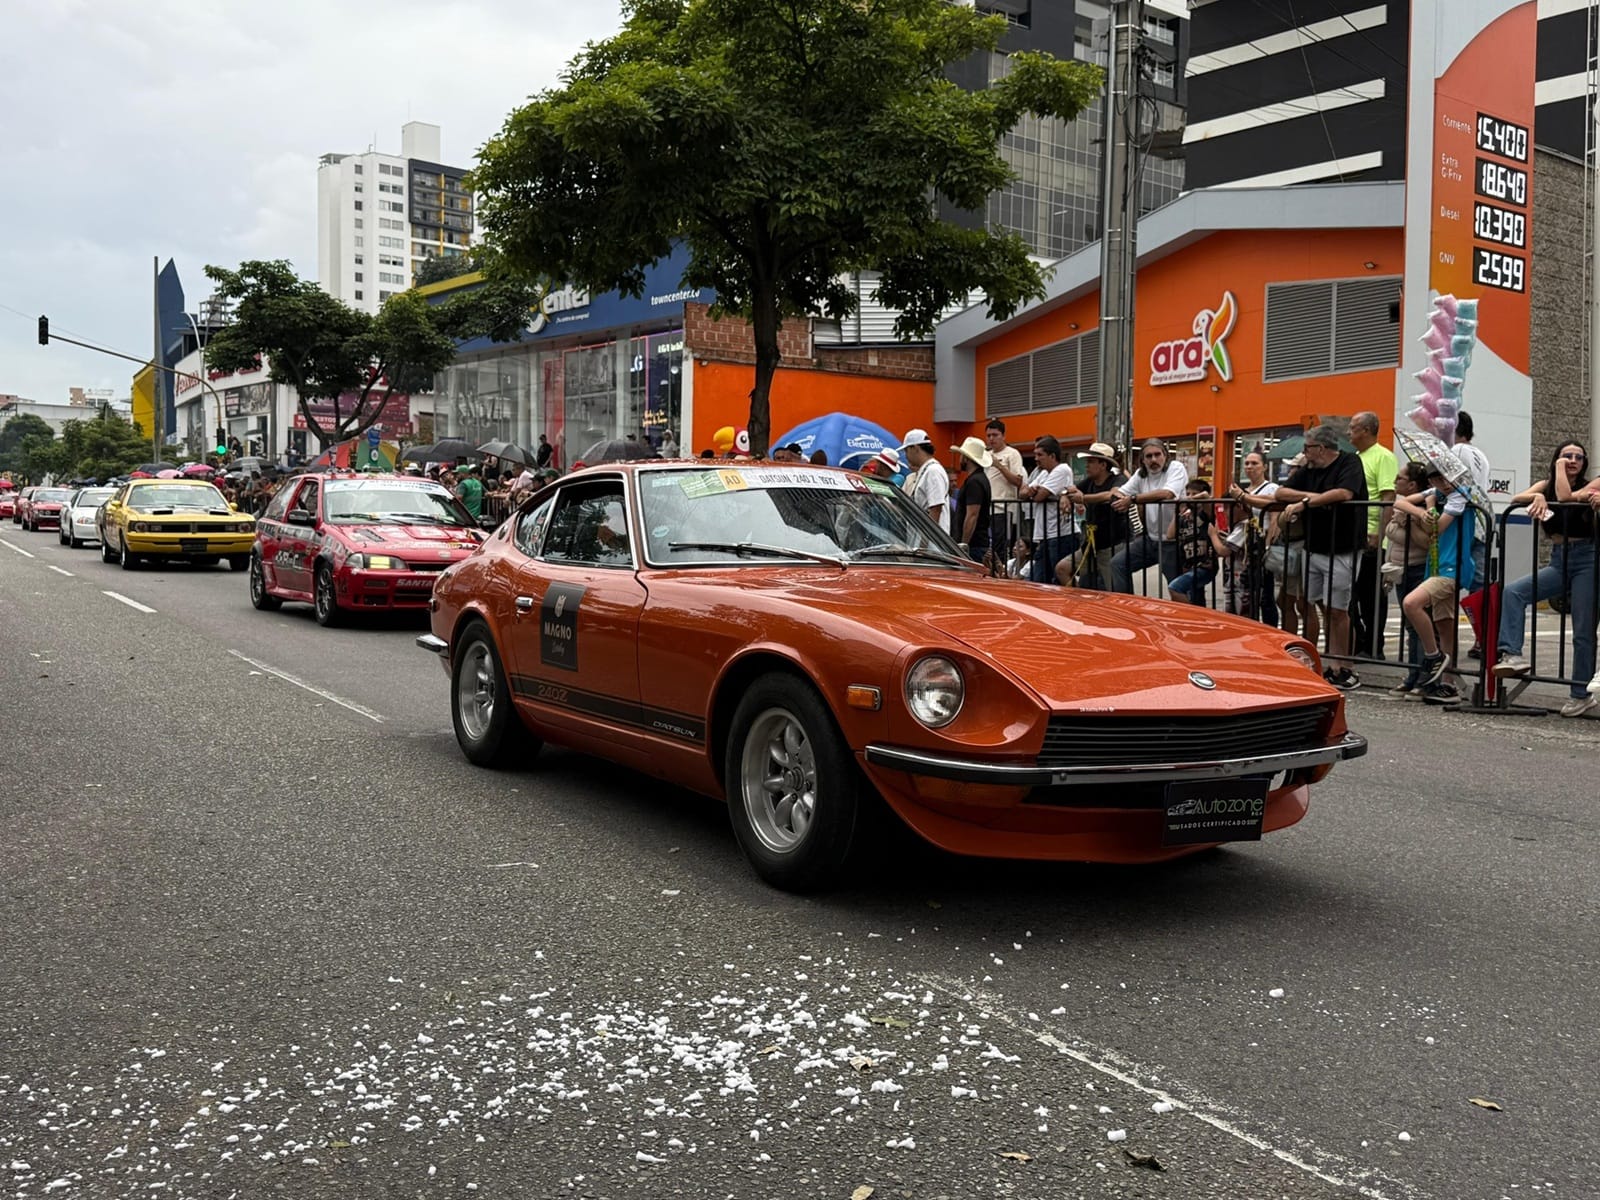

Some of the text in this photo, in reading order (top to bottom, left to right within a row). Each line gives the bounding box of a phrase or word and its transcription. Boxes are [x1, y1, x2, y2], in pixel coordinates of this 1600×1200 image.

[1442, 153, 1458, 168] Extra
[1441, 205, 1460, 220] Diesel
[1440, 252, 1455, 265] GNV
[1152, 340, 1203, 373] ara
[846, 439, 885, 449] Electrolit
[725, 475, 741, 486] AD
[759, 473, 792, 484] DATSUN
[818, 476, 839, 486] 1972
[1488, 479, 1510, 491] uper
[544, 621, 572, 640] MAGNO
[537, 684, 569, 702] 240Z
[652, 720, 697, 737] DATSUN
[1202, 819, 1250, 828] CERTIFICADOS
